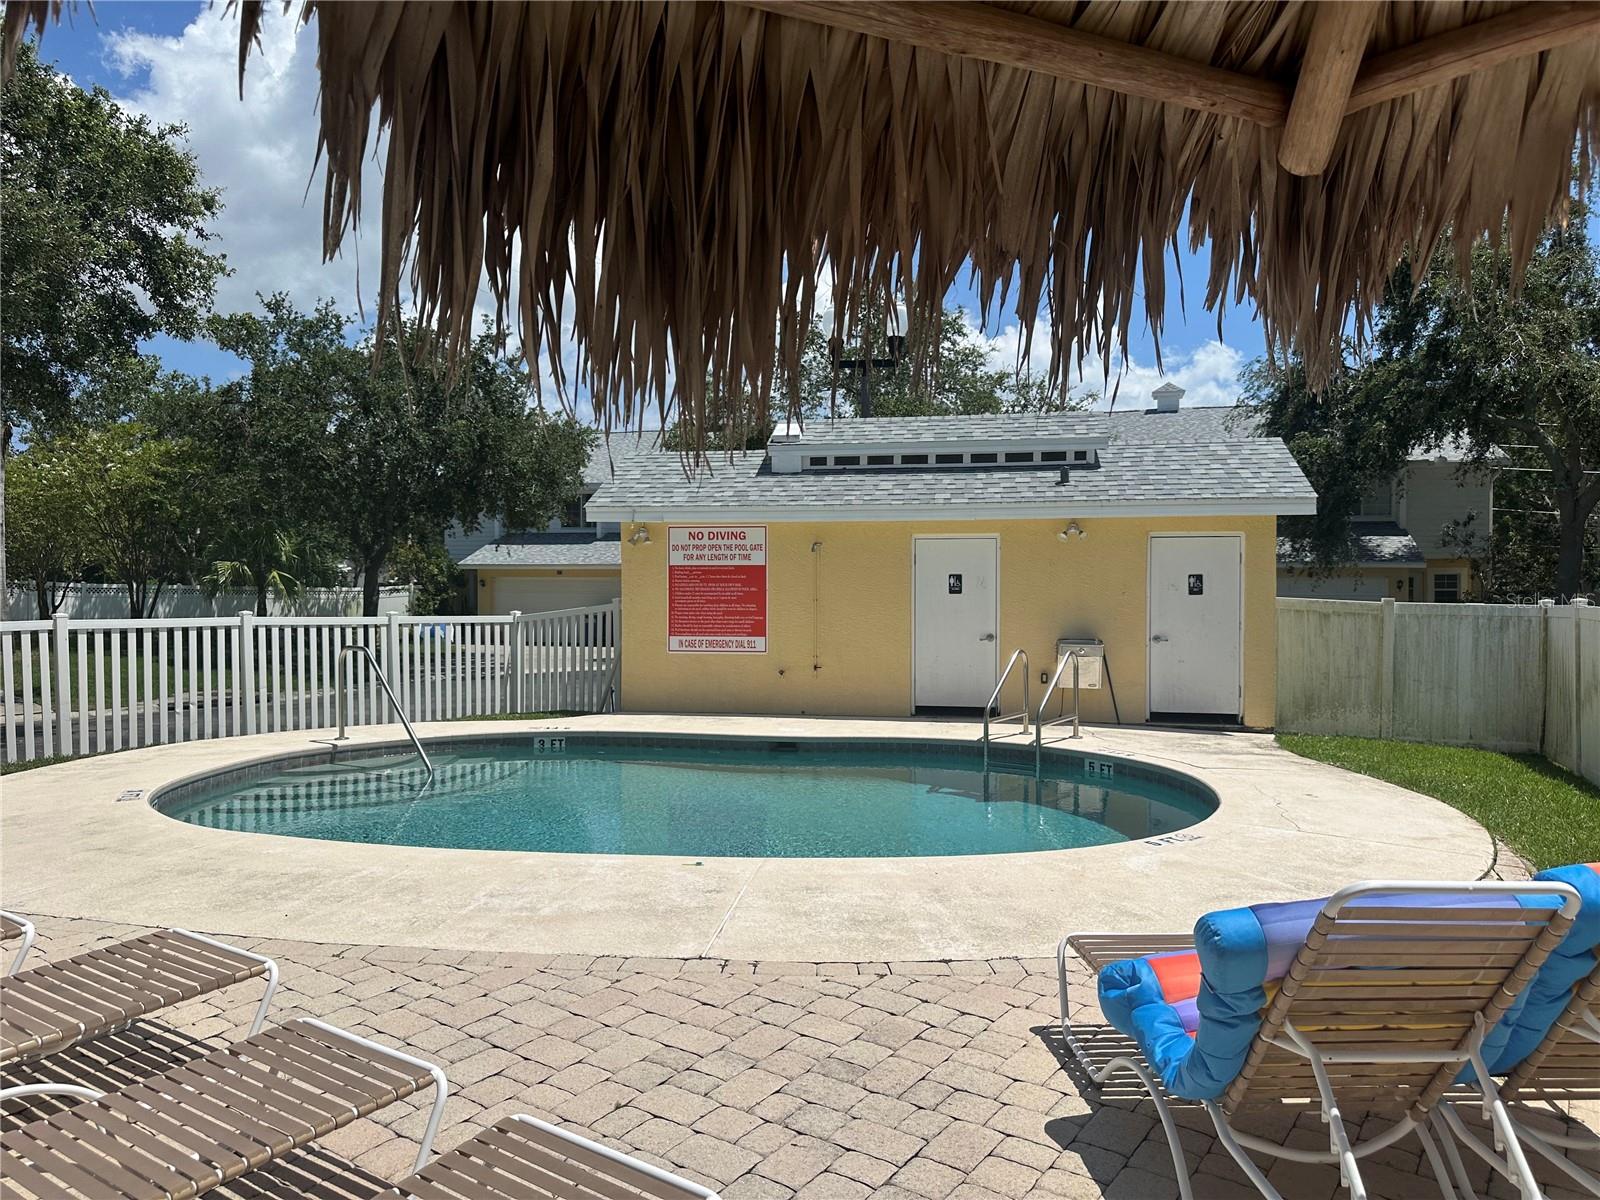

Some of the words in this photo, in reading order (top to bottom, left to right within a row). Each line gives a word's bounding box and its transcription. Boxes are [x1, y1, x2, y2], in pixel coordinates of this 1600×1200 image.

[688, 531, 704, 541] NO
[708, 531, 746, 541] DIVING
[672, 544, 679, 552] DO
[680, 544, 691, 552] NOT
[692, 544, 706, 552] PROP
[707, 544, 722, 552] OPEN
[723, 544, 733, 552] THE
[734, 544, 748, 552] POOL
[749, 544, 763, 552] GATE
[683, 553, 694, 561] FOR
[695, 553, 706, 561] ANY
[707, 553, 728, 561] LENGTH
[729, 553, 736, 561] OF
[738, 553, 751, 561] TIME
[679, 639, 683, 648] IN
[684, 639, 697, 648] CASE
[698, 639, 704, 648] OF
[705, 639, 734, 648] EMERGENCY
[735, 639, 746, 648] DIAL
[747, 639, 756, 648] 911
[538, 739, 545, 751] 3
